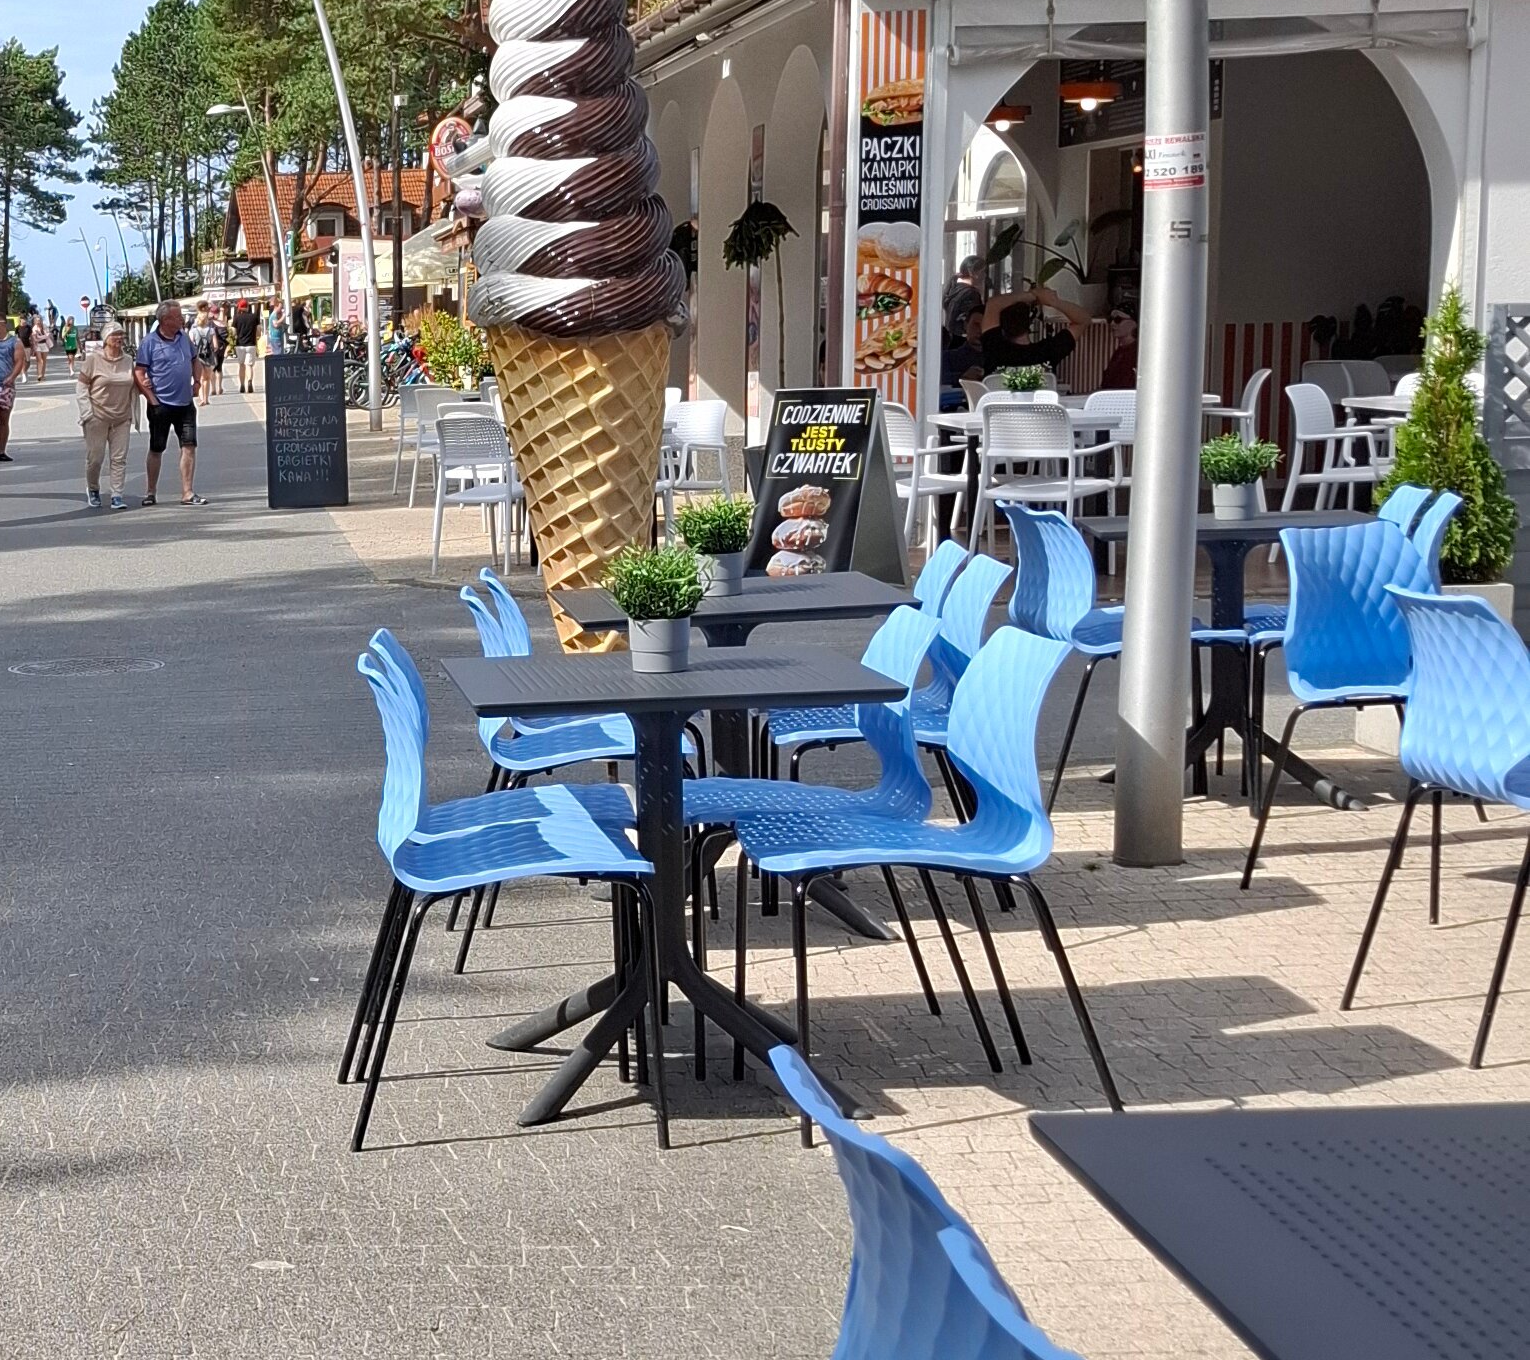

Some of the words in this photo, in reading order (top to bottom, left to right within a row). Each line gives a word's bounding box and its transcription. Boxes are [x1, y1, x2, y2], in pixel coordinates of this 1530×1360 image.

[861, 135, 920, 161] PĄCZKI
[861, 159, 919, 179] KANAPKI
[1153, 167, 1177, 177] 520
[1181, 163, 1204, 175] 189
[861, 177, 919, 197] NALEŚNIKI
[860, 197, 918, 211] CROISSANTY
[273, 360, 332, 379] NALEŚNIKI
[781, 404, 866, 425] CODZIENNIE
[801, 425, 839, 439] JEST
[275, 441, 338, 454] CROISSANTY
[790, 438, 846, 451] TŁUSTY
[277, 455, 332, 467] BAGIETKI
[771, 452, 858, 474] CZWARTEK
[279, 469, 312, 483] KAWA
